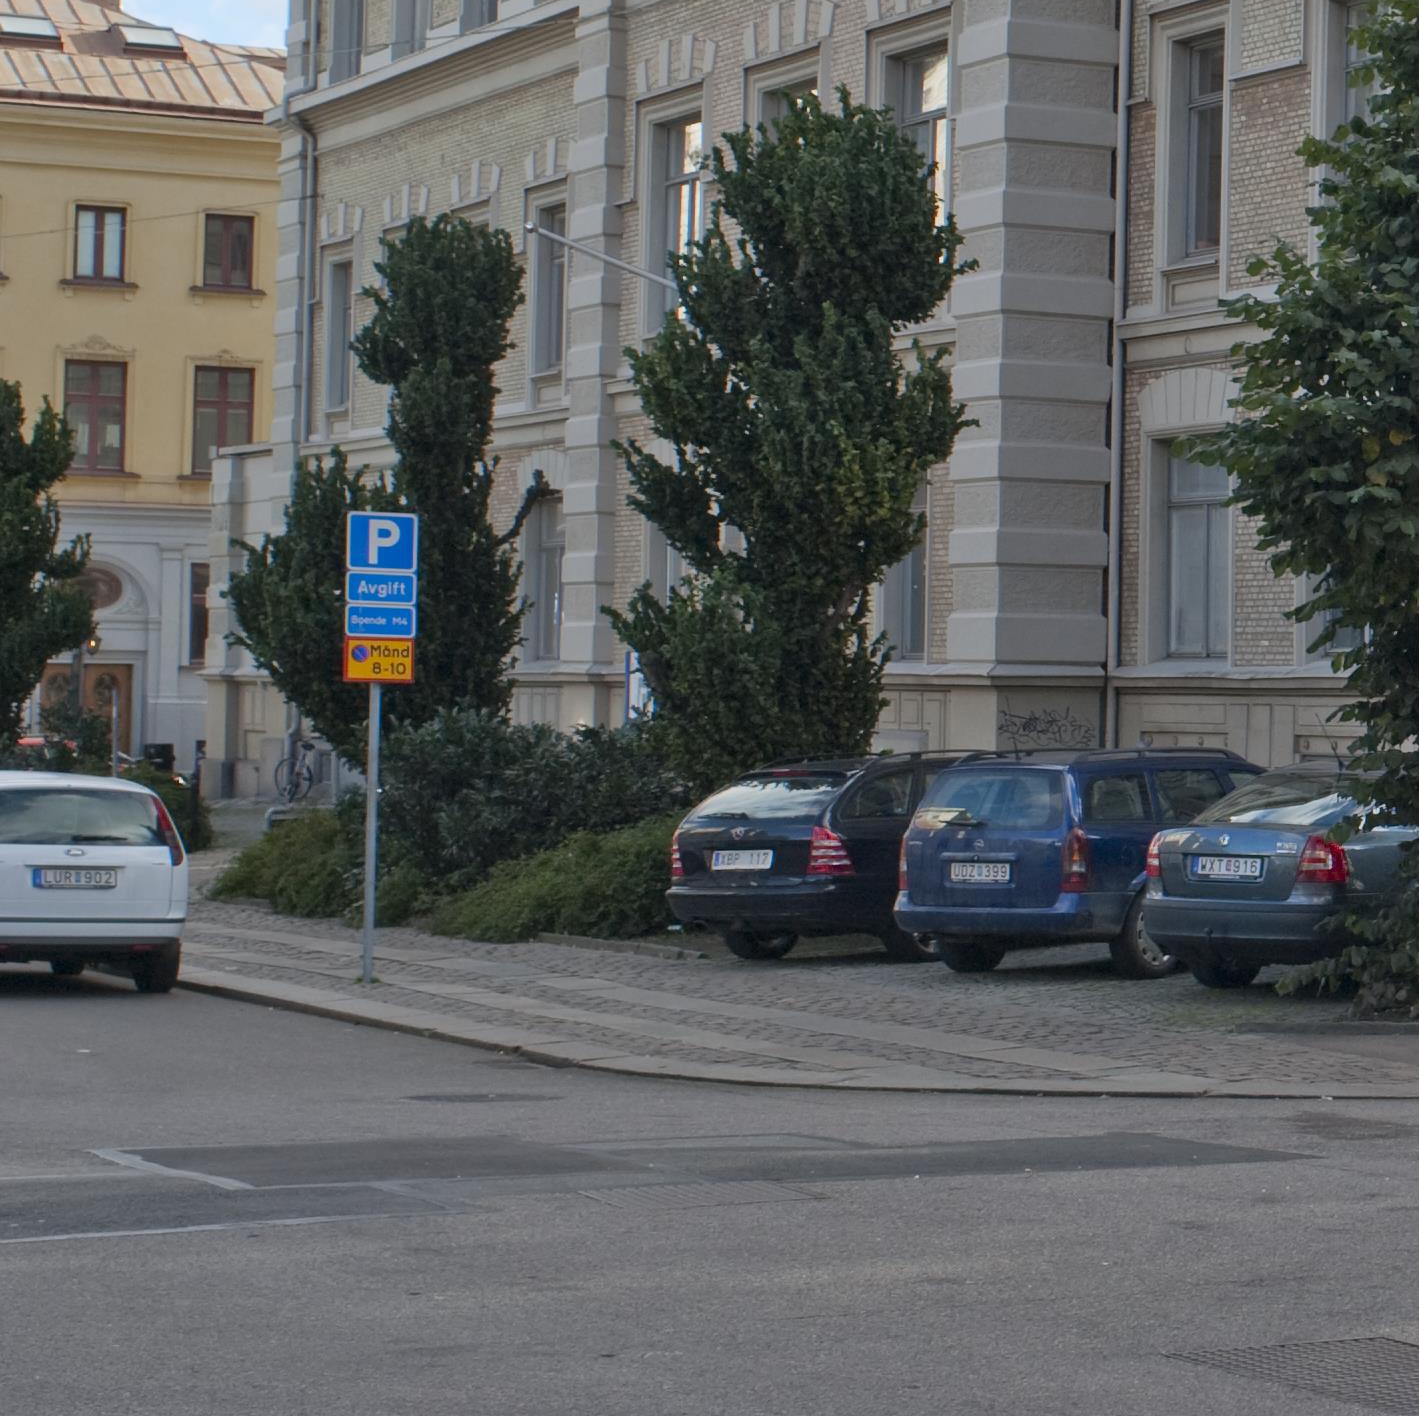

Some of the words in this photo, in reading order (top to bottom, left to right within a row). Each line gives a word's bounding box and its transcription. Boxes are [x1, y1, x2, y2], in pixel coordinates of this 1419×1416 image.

[368, 518, 401, 565] P
[357, 580, 406, 598] Avgift
[351, 615, 387, 626] Boende
[392, 616, 408, 626] M4
[370, 644, 410, 659] Månd
[372, 662, 406, 675] 8-10
[984, 865, 1008, 879] 399
[1233, 859, 1258, 874] 916
[43, 871, 73, 884] LUR
[84, 871, 113, 884] 902
